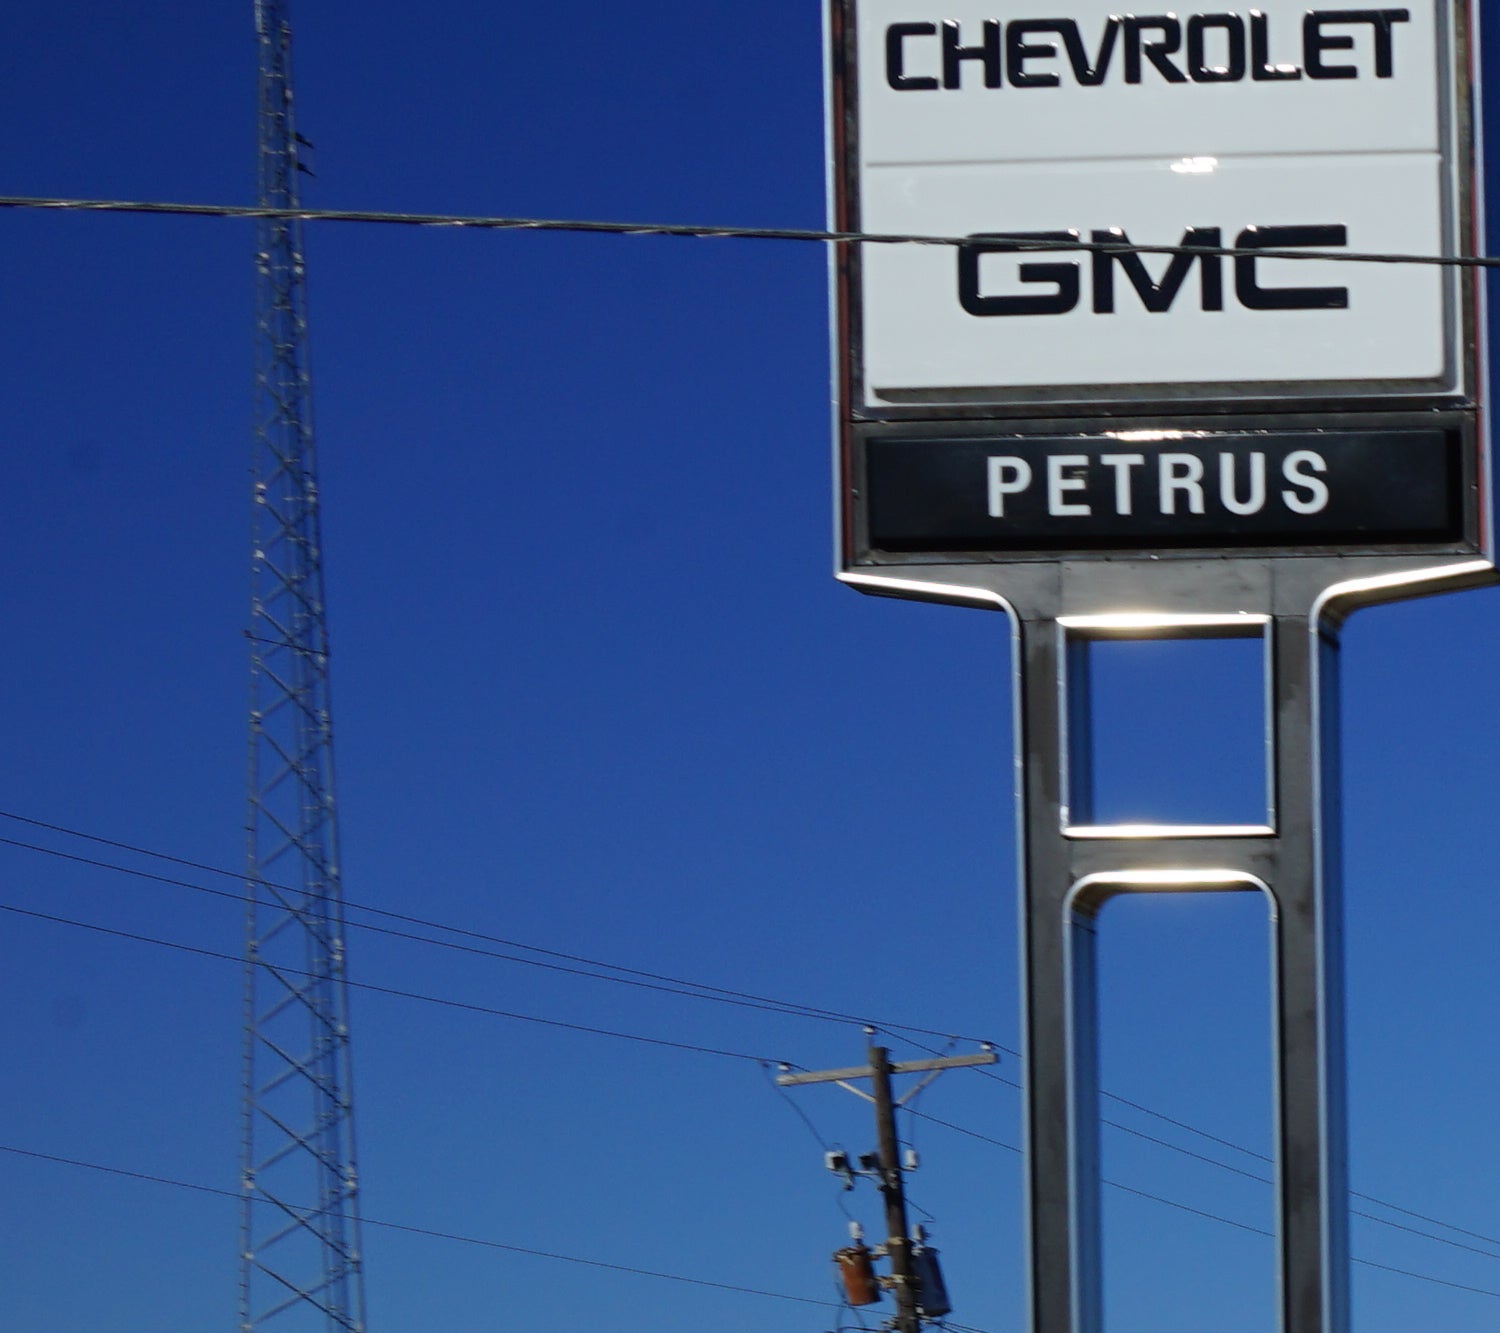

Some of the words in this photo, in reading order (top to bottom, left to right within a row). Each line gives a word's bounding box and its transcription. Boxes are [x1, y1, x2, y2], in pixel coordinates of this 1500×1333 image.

[885, 9, 1410, 91] CHEVROLET
[956, 223, 1349, 317] GMC
[986, 450, 1330, 518] PETRUS
